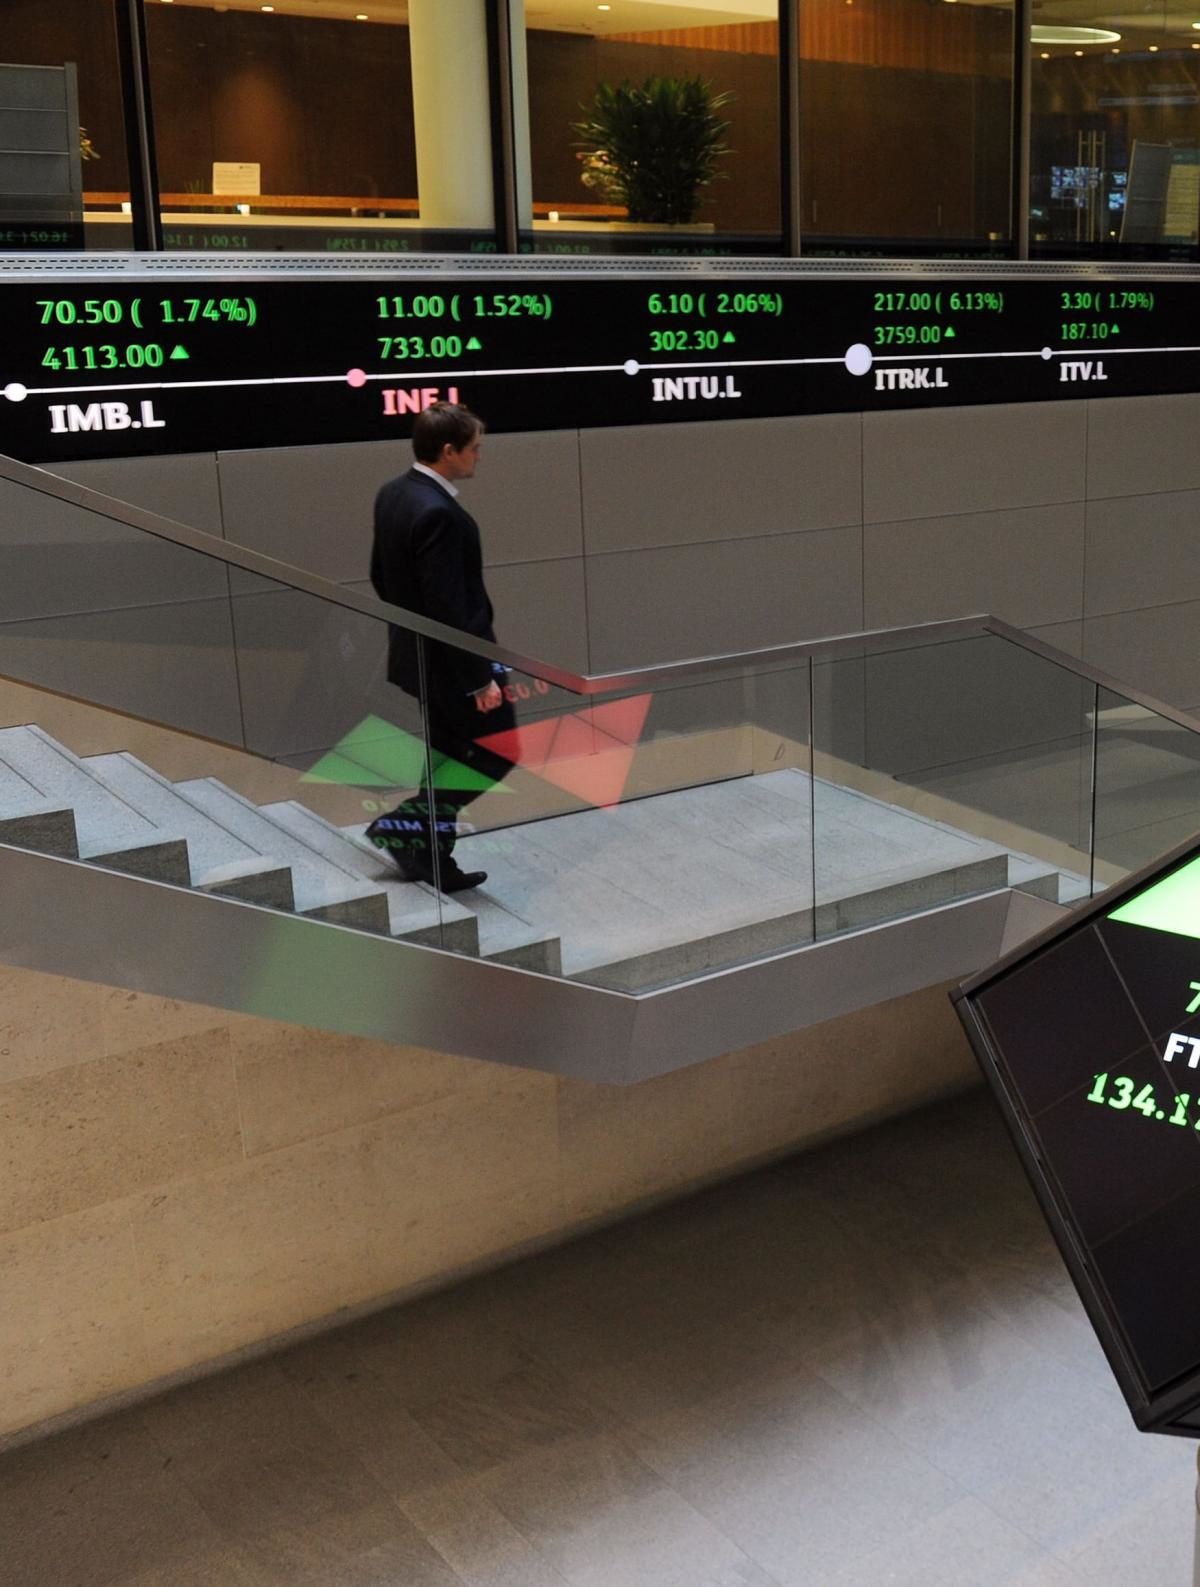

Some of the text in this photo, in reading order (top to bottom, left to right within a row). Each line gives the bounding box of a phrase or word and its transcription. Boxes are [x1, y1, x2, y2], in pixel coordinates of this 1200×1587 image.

[376, 296, 445, 318] 11.00
[648, 294, 693, 314] 6.10
[874, 293, 931, 311] 217.00
[1061, 292, 1092, 309] 3.30
[36, 300, 123, 326] 70.50
[649, 330, 719, 351] 302.30
[874, 326, 941, 345] 3759.00
[1061, 323, 1108, 340] 187.10
[41, 344, 163, 370] 4113.00
[377, 336, 462, 359] 733.00
[874, 367, 949, 391] ITRK.L
[1059, 361, 1108, 382] ITV.L
[652, 375, 742, 402] INTU.L
[48, 400, 166, 434] IMB.L
